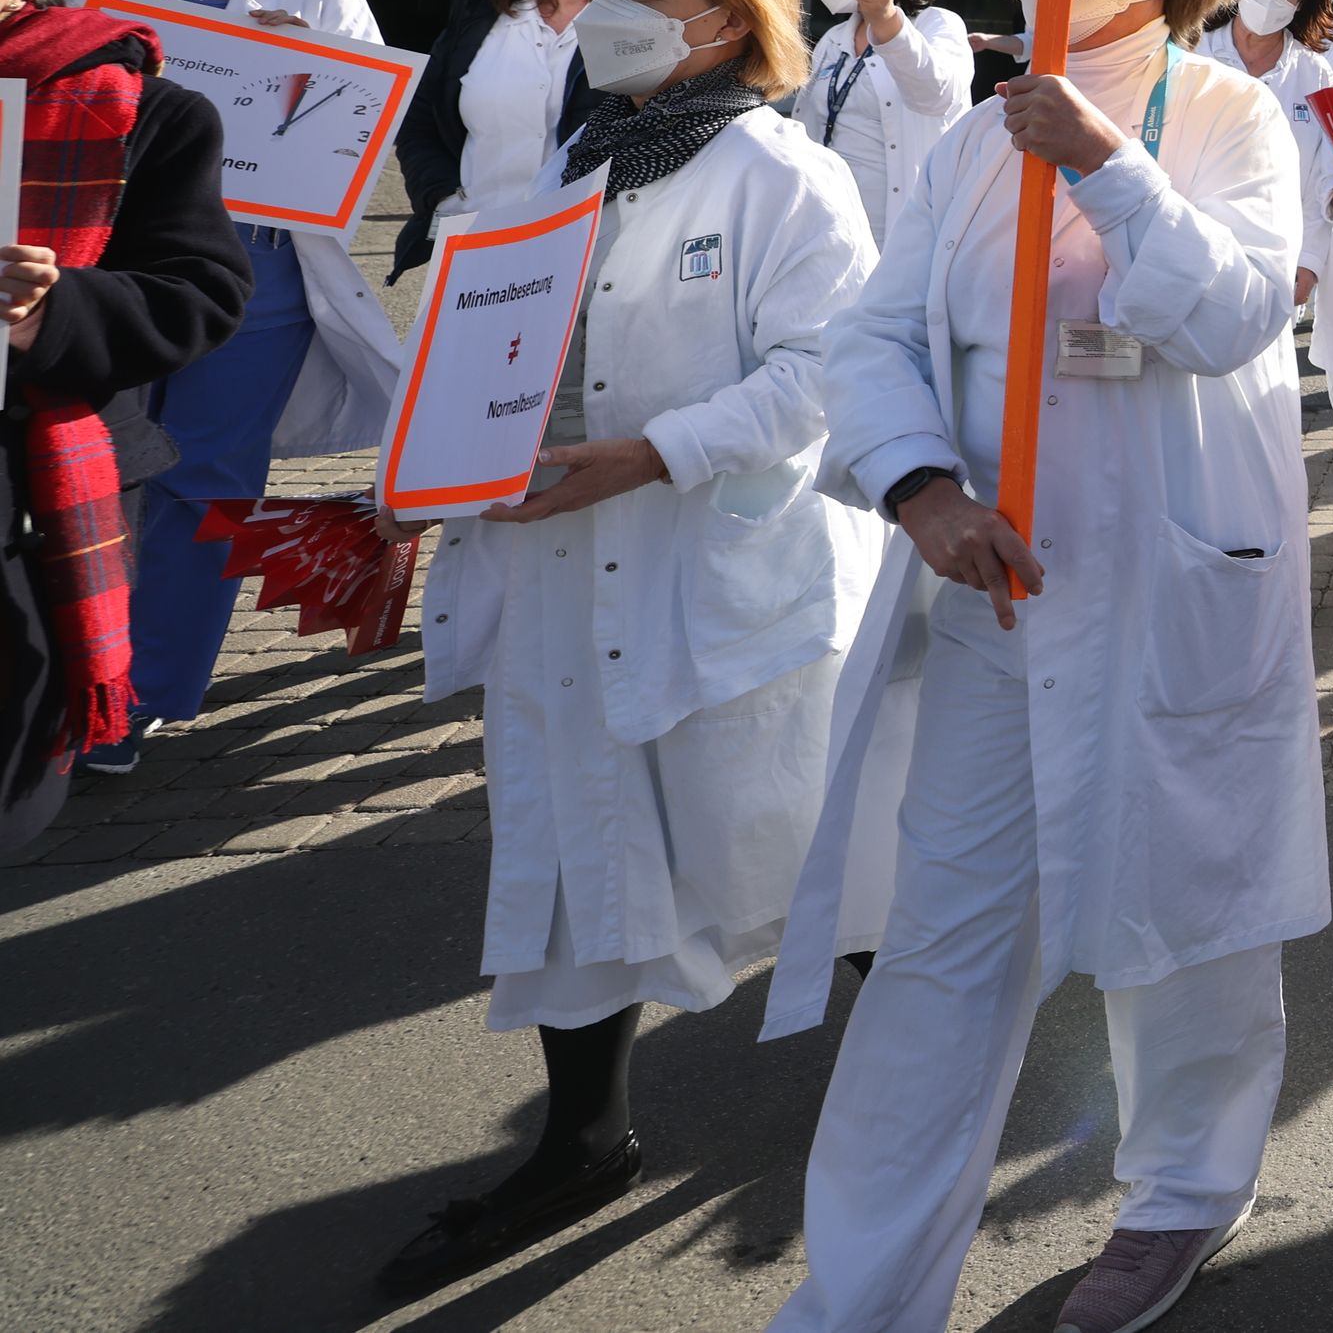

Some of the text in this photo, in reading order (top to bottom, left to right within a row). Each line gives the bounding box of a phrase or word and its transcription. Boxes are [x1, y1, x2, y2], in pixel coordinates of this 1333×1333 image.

[266, 82, 280, 94] 11
[233, 95, 254, 107] 10
[353, 104, 367, 115] 2
[357, 131, 370, 143] 3
[456, 274, 554, 310] Minimalbesetzung
